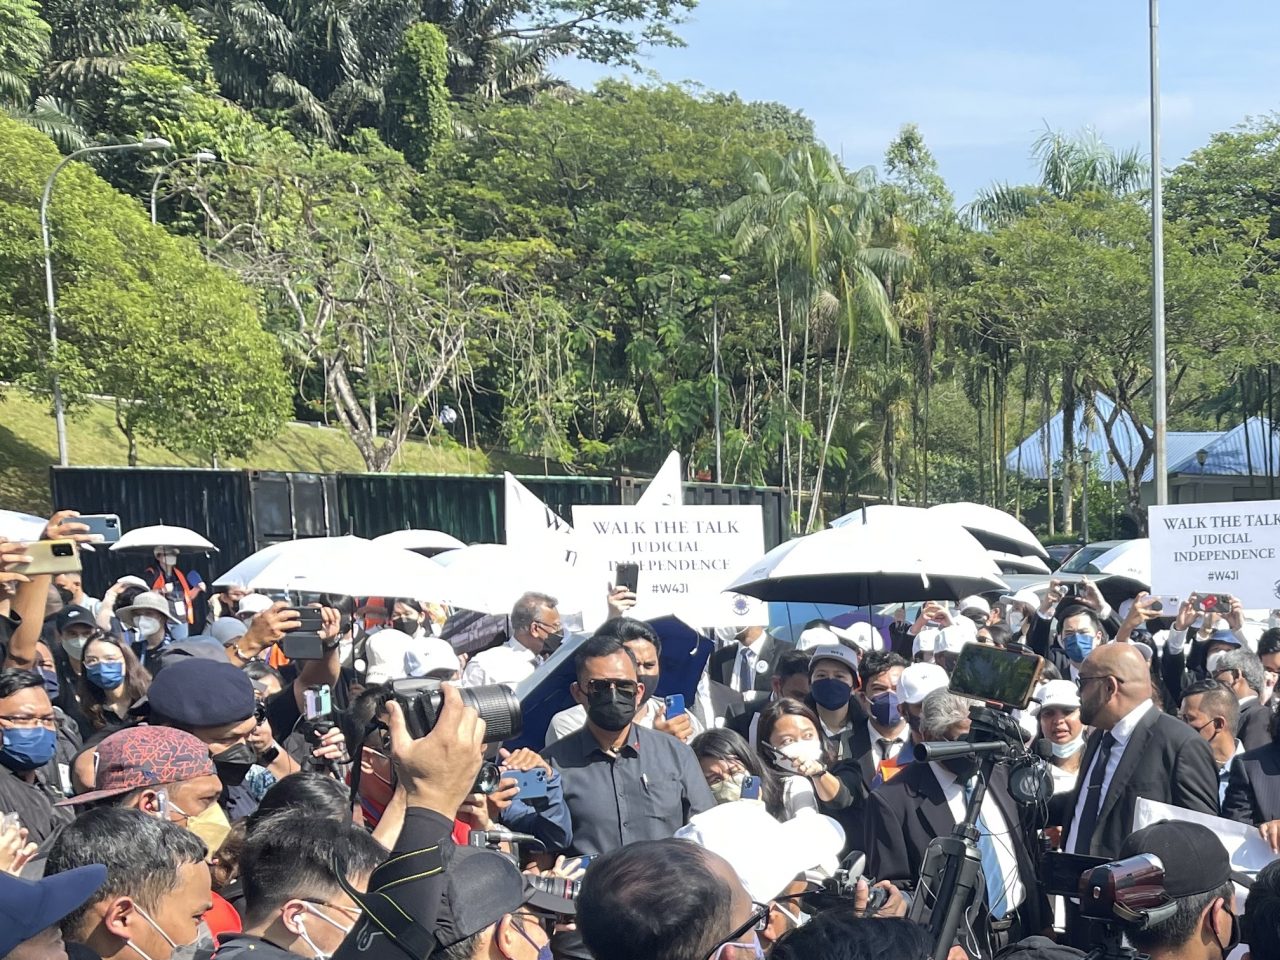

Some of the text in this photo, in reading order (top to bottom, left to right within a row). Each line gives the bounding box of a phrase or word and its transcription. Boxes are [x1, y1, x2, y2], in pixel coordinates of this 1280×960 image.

[593, 520, 739, 534] WALK THE TALK
[1163, 516, 1208, 530] WALK
[1209, 515, 1241, 528] THE
[1192, 532, 1253, 548] JUDICIAL
[630, 541, 702, 555] JUDICIAL
[1173, 548, 1276, 562] INDEPENDENCE
[608, 559, 731, 571] INEPENDENCE
[1207, 570, 1239, 581] #W4JI
[652, 584, 689, 594] #W4JI
